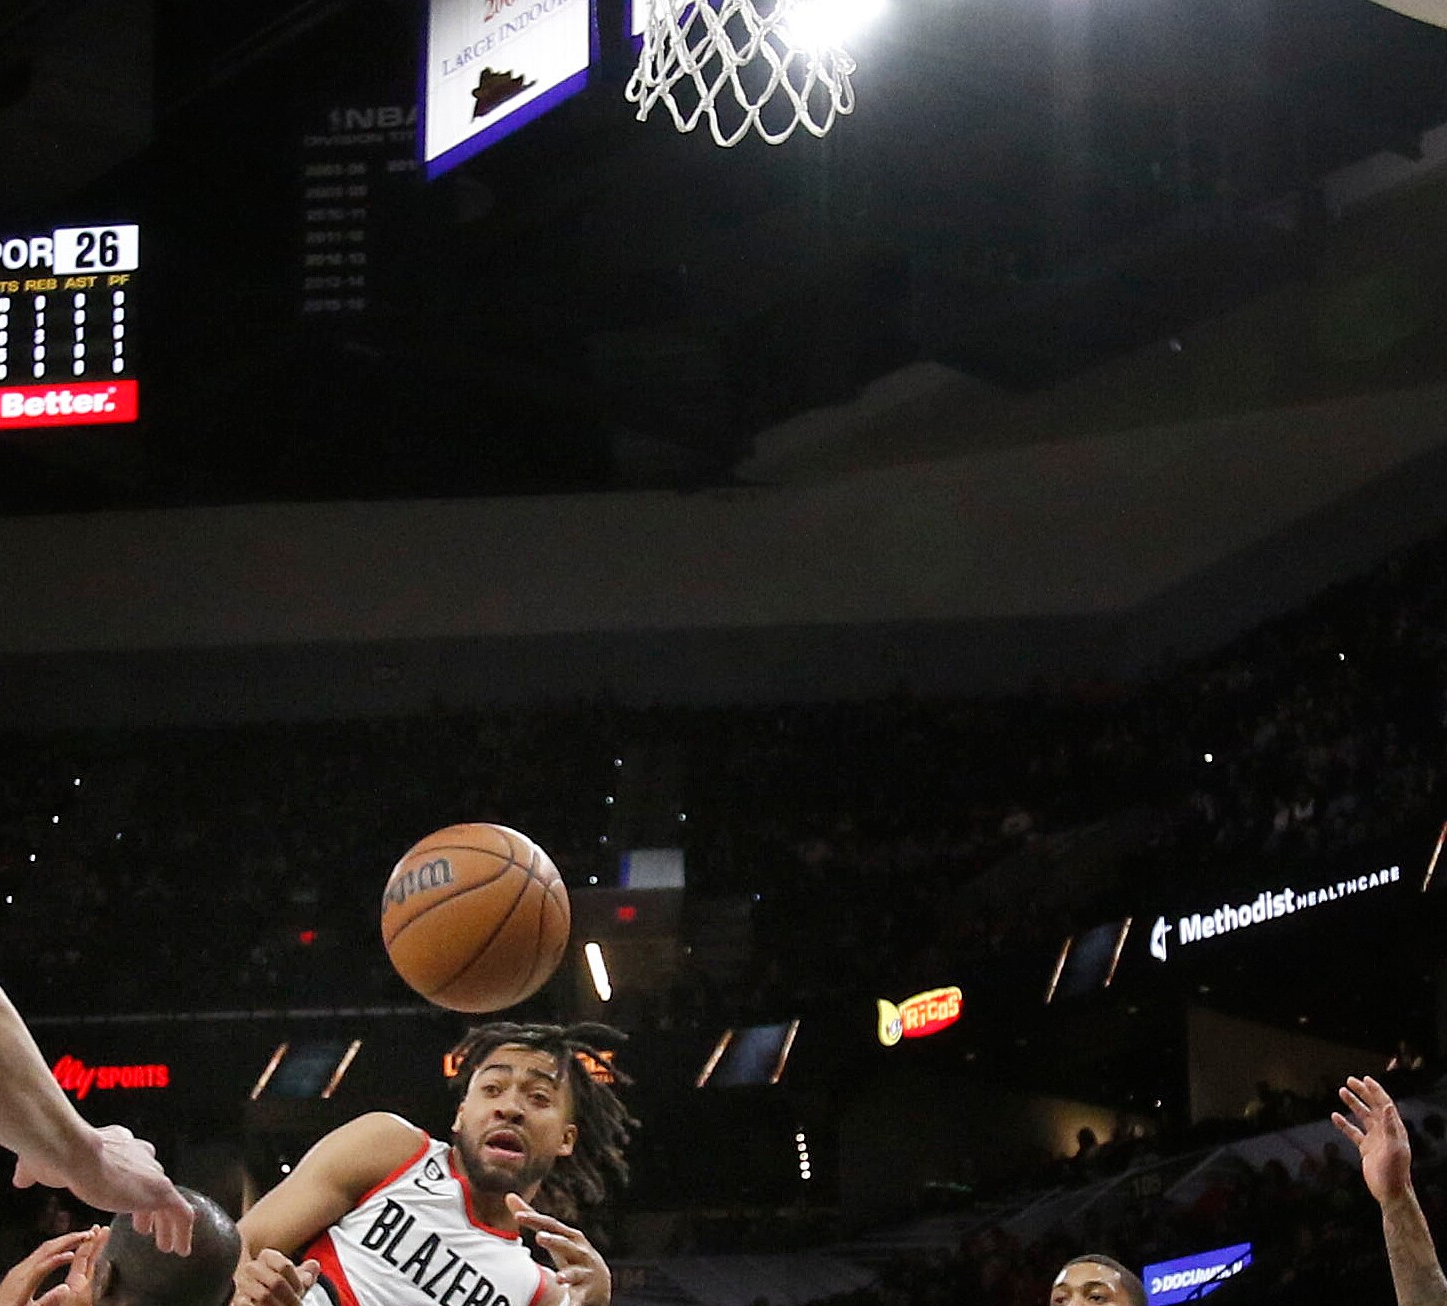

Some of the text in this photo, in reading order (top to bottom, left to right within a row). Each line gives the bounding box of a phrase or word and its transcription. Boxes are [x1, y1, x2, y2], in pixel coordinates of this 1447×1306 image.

[442, 32, 495, 77] LARGE
[498, 0, 566, 41] INDOO
[76, 231, 119, 269] 26
[24, 278, 58, 292] REB
[64, 276, 98, 290] AST
[107, 274, 131, 288] PF
[0, 388, 116, 418] Better.
[1179, 866, 1401, 945] Methodist HEALTHCARE
[97, 1064, 170, 1089] SPORTS
